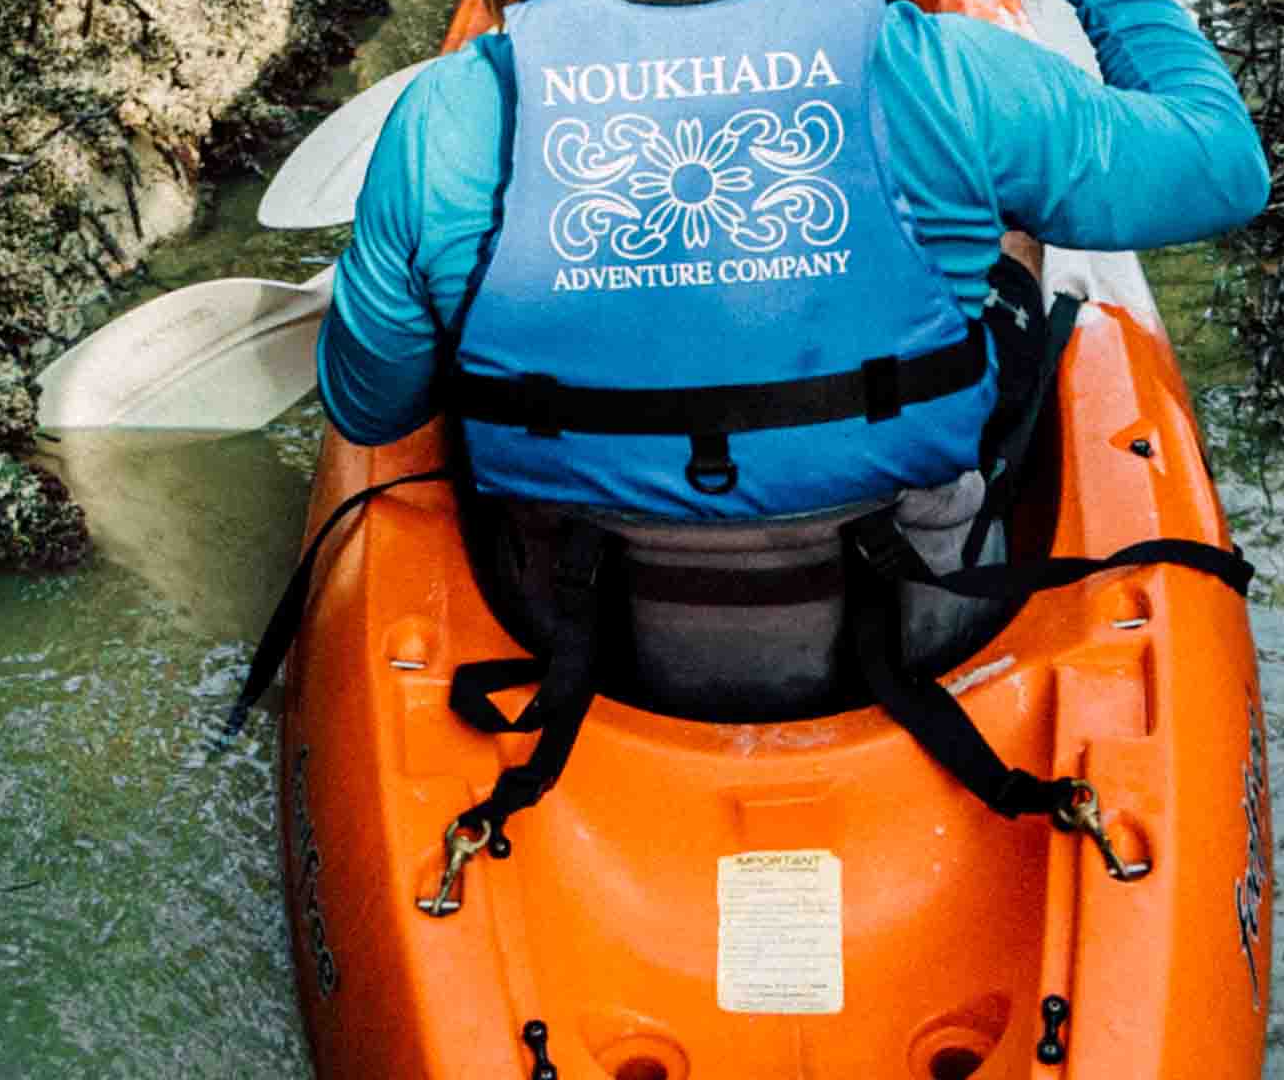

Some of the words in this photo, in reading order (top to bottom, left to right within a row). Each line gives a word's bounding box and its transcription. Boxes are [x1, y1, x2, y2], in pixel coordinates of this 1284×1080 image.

[541, 47, 843, 107] NOUKHADA
[552, 260, 715, 292] ADVENTURE
[718, 249, 852, 285] COMPANY
